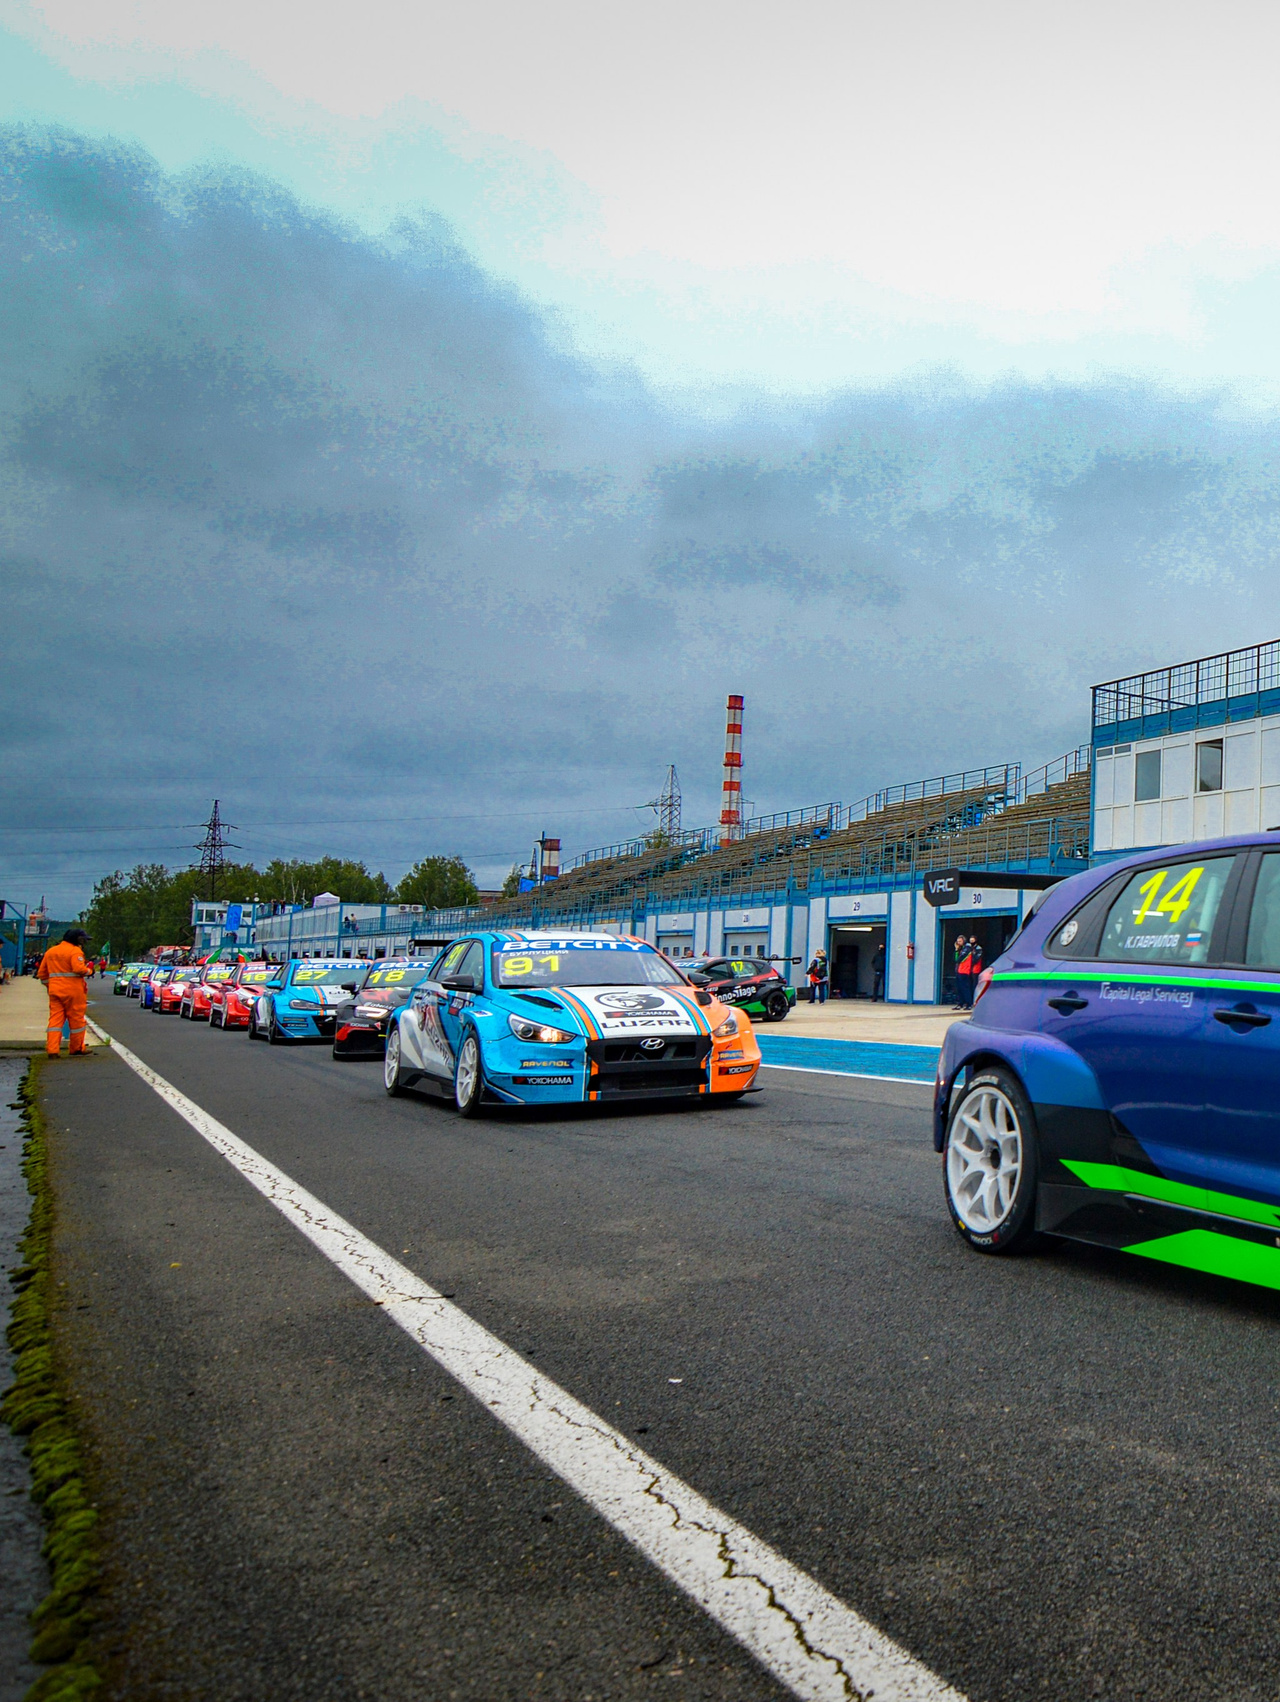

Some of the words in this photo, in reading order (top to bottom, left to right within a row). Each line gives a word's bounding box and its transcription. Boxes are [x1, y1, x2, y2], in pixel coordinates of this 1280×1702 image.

[928, 877, 954, 893] VRC
[972, 893, 982, 904] 30
[1134, 867, 1205, 925] 14
[853, 901, 861, 911] 29
[502, 940, 645, 951] BETCITY
[1124, 934, 1181, 949] К.ГАВРИЛОВ
[504, 955, 560, 976] 91
[731, 961, 744, 972] 17
[242, 973, 267, 981] 16
[295, 971, 328, 981] 27
[369, 971, 405, 984] 18
[1103, 987, 1130, 1001] Capital
[1130, 988, 1153, 1004] Legal
[1154, 988, 1190, 1003] Services
[601, 1019, 693, 1028] LUZAR
[522, 1060, 572, 1068] RAVENOL
[527, 1076, 573, 1085] YOKOHAMA
